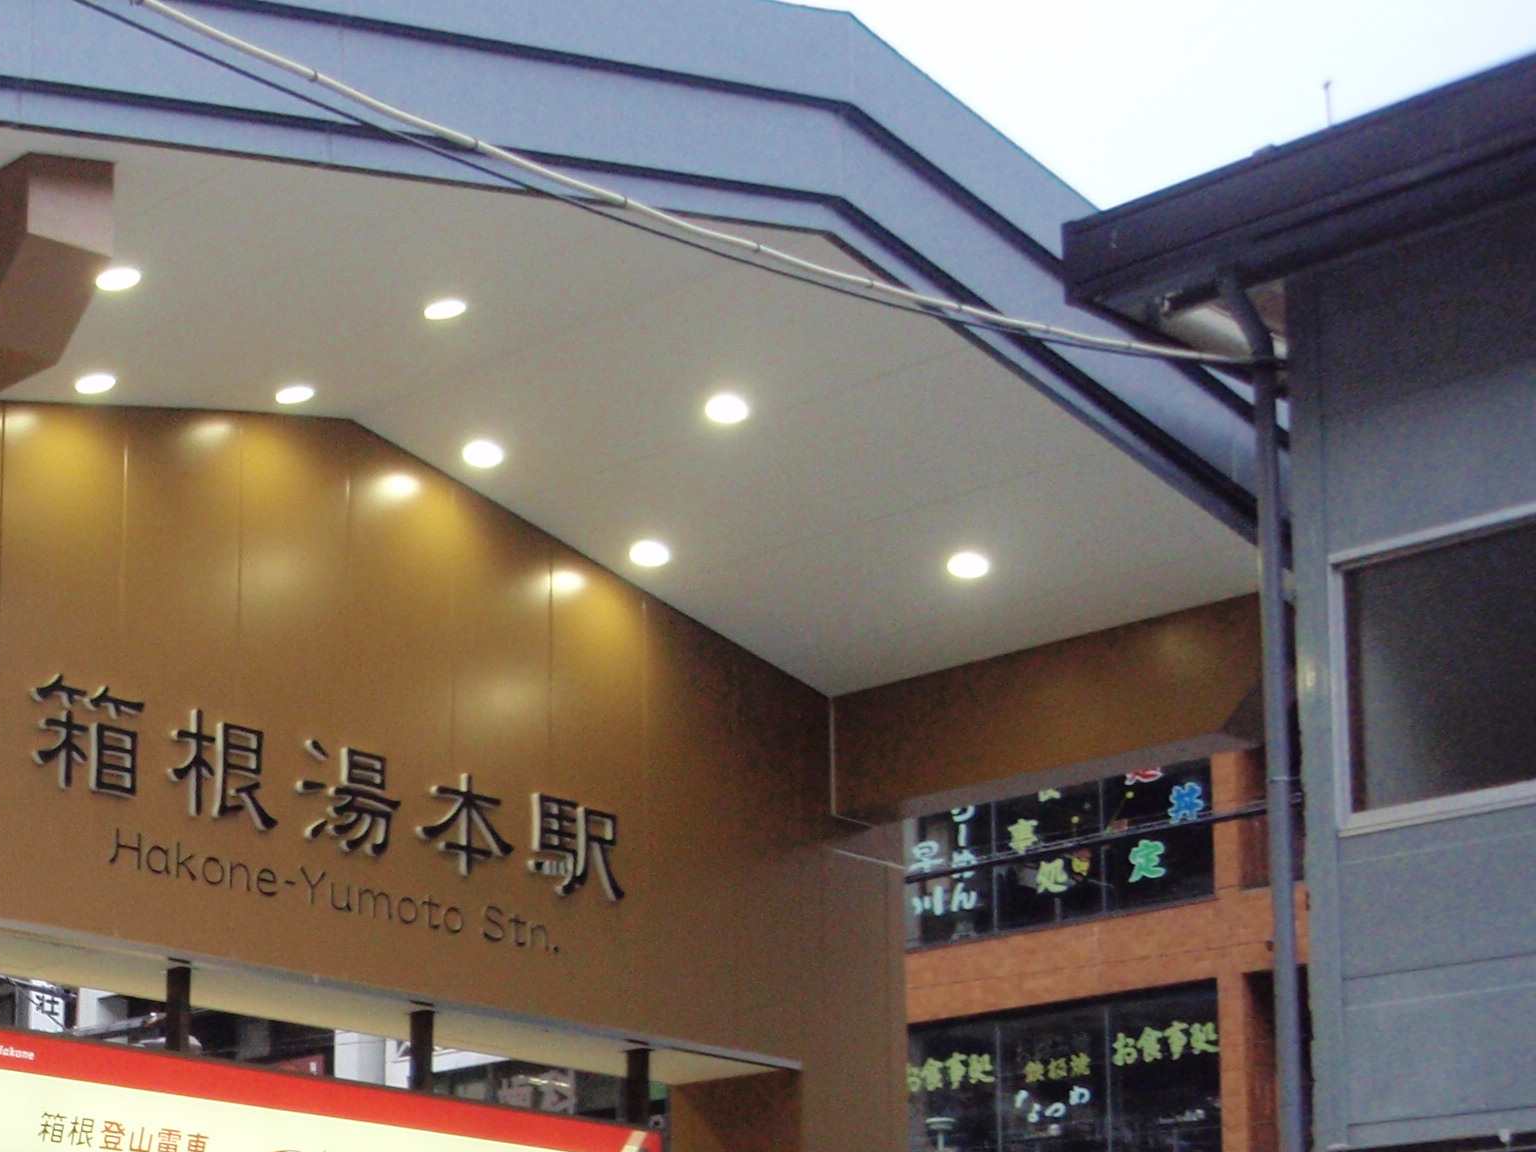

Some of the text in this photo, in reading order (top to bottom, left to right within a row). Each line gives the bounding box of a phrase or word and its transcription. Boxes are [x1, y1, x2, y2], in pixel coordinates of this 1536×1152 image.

[30, 673, 625, 901] 箱根湯本駅
[109, 828, 561, 953] Hakone-Yumoto Stn.
